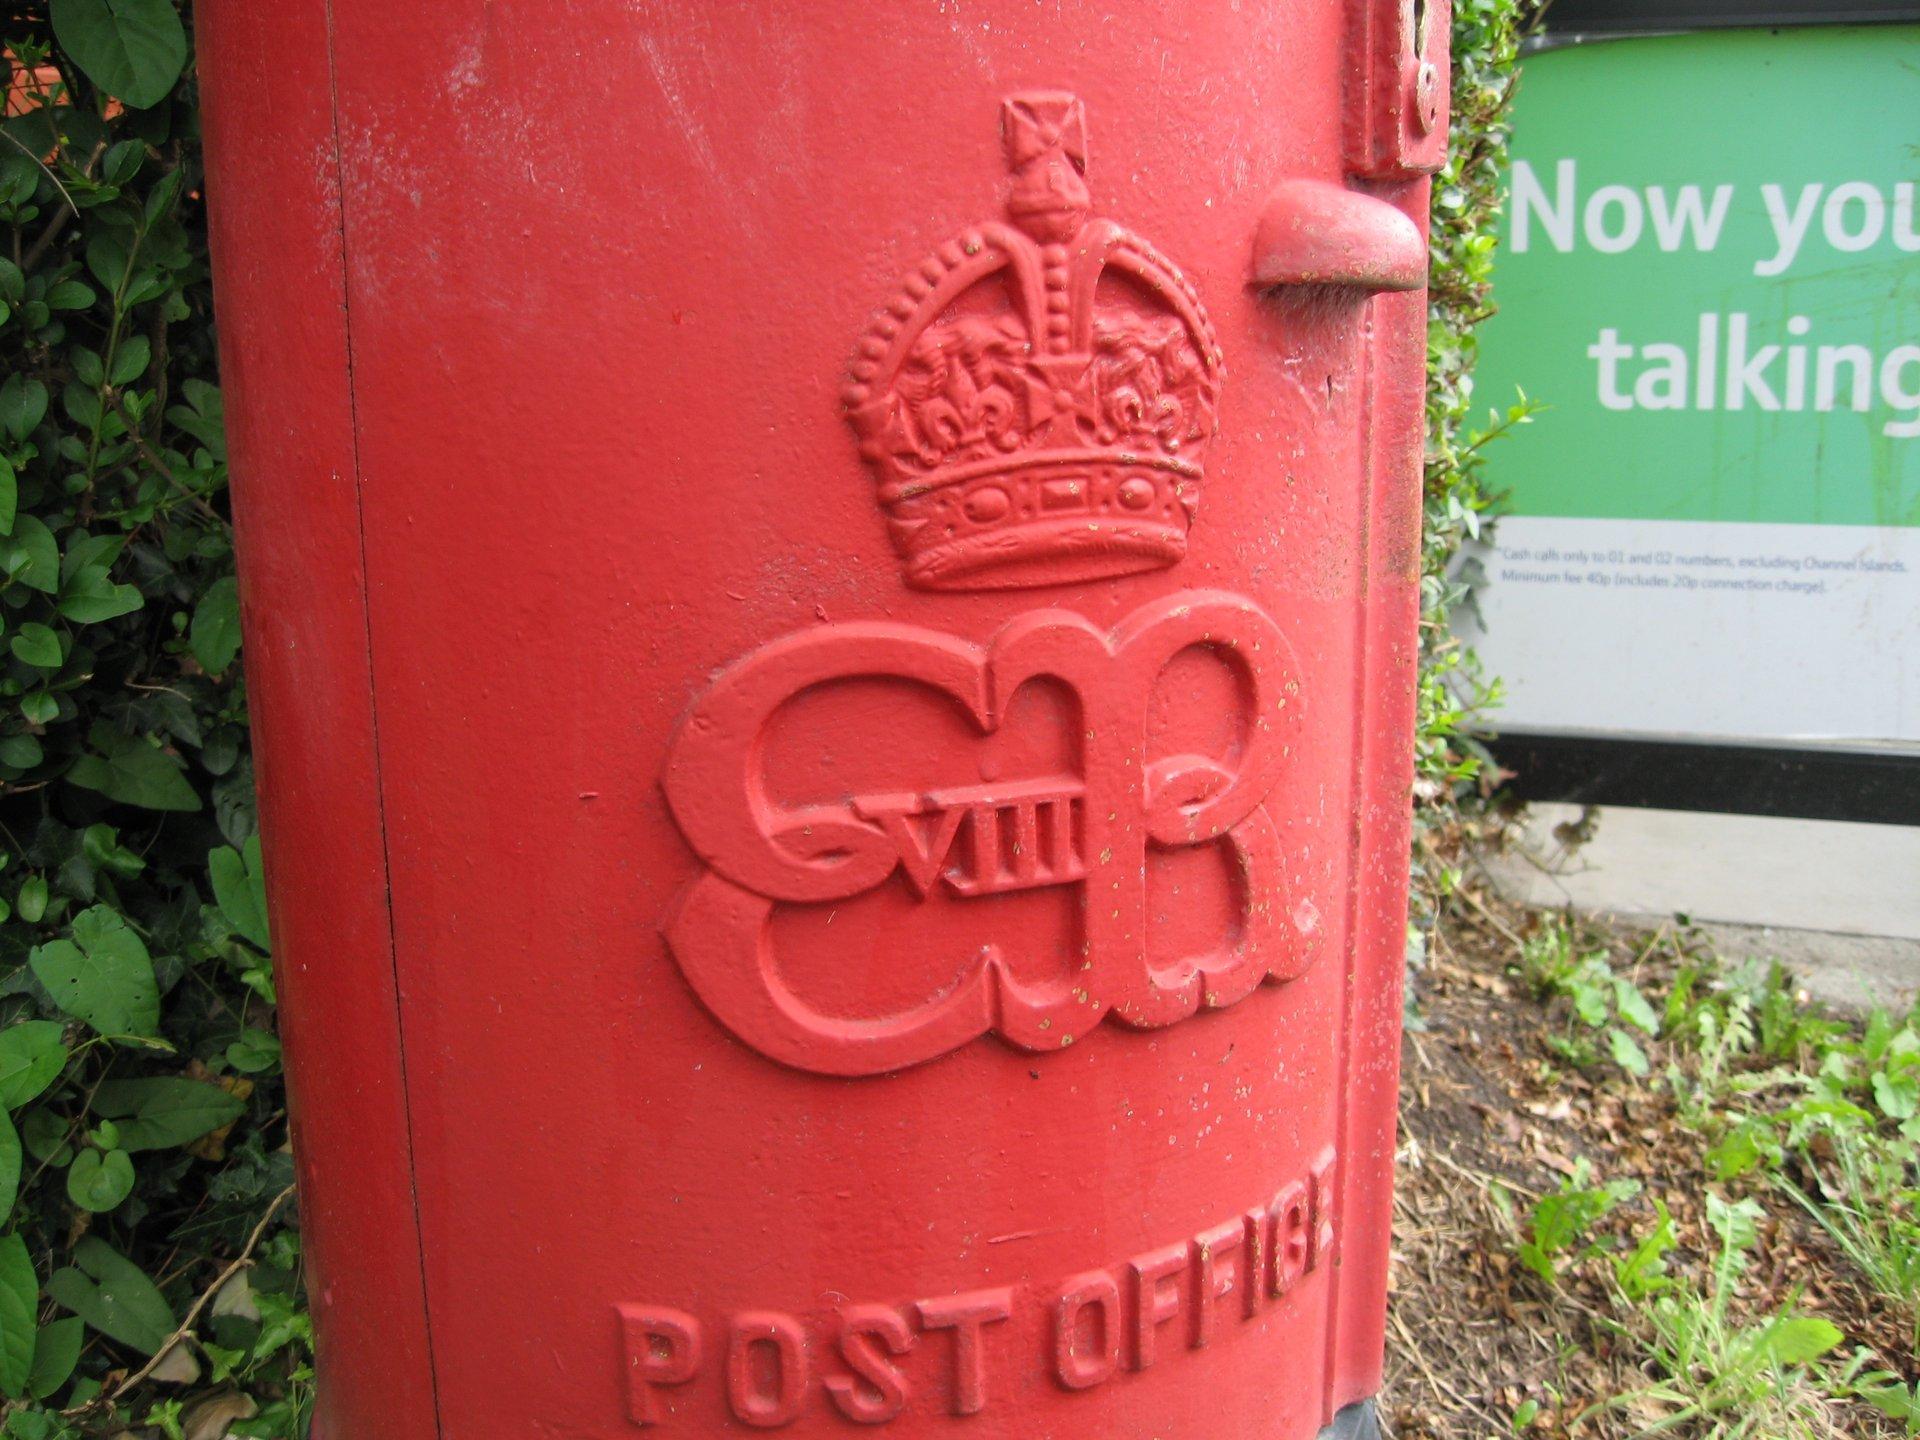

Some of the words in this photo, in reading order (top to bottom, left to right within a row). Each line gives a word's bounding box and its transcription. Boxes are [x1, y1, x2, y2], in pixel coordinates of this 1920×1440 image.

[1510, 158, 1734, 253] Now
[1587, 312, 1920, 438] talking
[612, 1283, 1012, 1428] POST
[1052, 1143, 1338, 1392] OFFICE
